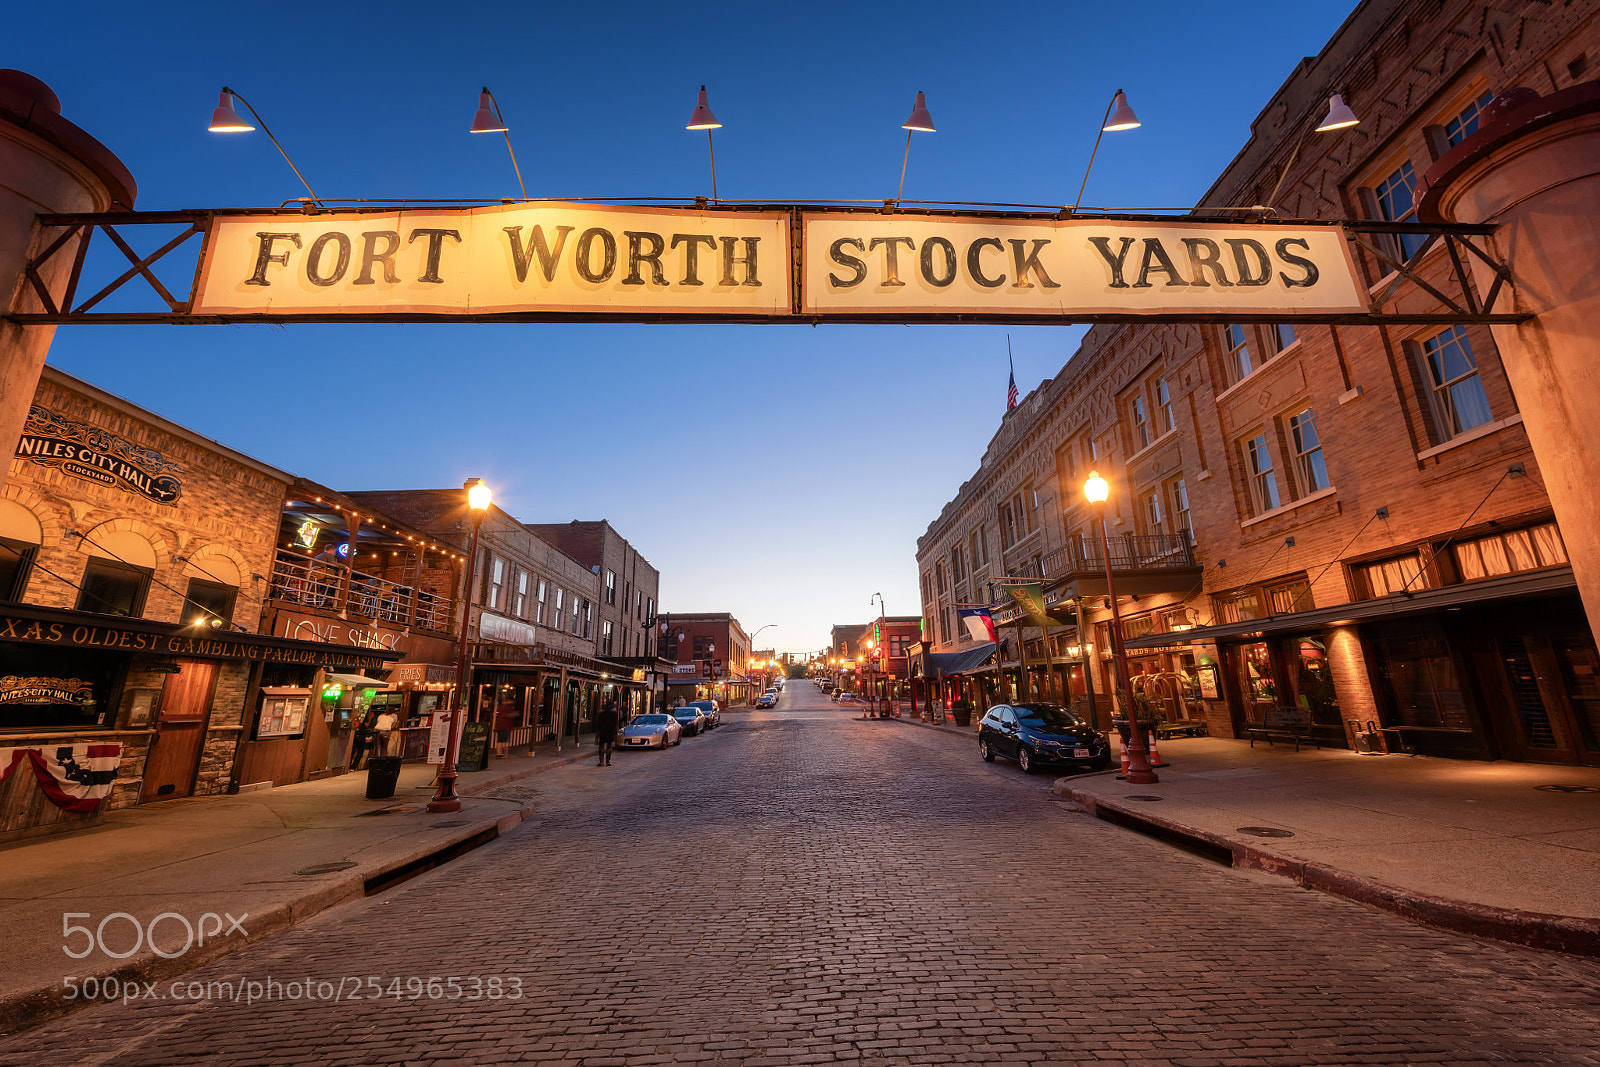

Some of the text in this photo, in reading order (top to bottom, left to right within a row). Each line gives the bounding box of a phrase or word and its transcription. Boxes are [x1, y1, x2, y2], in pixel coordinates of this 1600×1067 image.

[244, 224, 1321, 289] FORT WORTH STOCK YARDS
[18, 437, 153, 495] NILES CITY HALL
[66, 463, 115, 484] STOCKYARDS
[0, 618, 383, 670] XAS OLDEST GAMBLING PARLOR AND CASINO
[347, 627, 402, 652] SHACK
[494, 619, 526, 644] SALOON
[399, 667, 422, 681] FRIES
[31, 688, 53, 697] CITY
[53, 690, 74, 702] HALL
